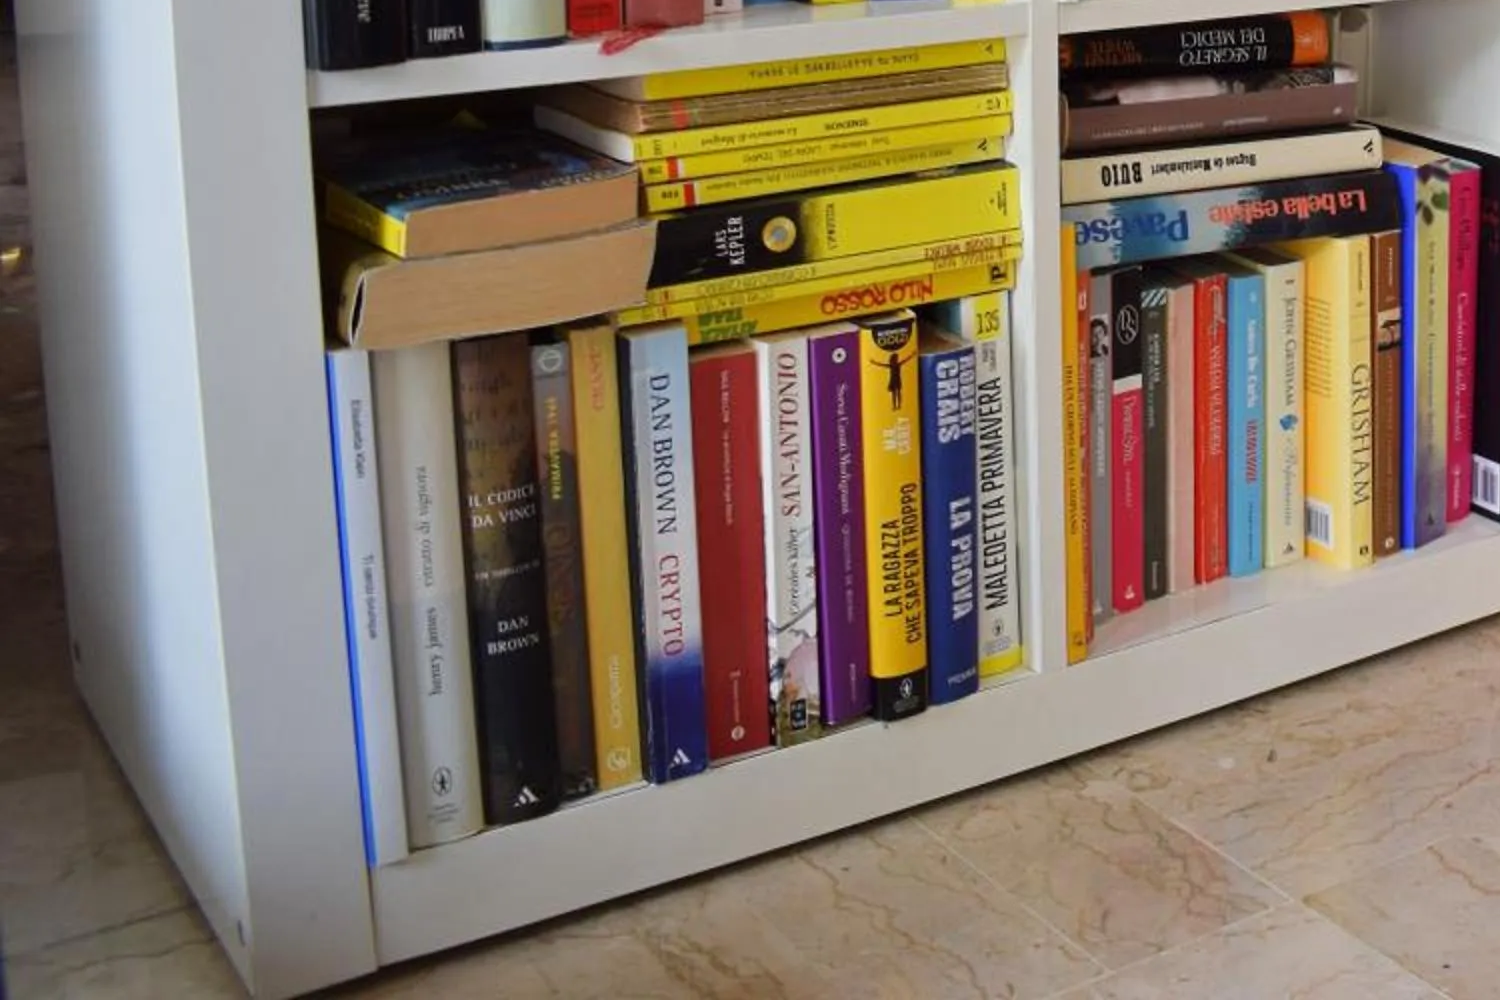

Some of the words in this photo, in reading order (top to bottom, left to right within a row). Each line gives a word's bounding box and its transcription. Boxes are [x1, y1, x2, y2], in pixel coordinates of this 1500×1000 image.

[1180, 29, 1238, 50] MEDICI
[1240, 27, 1266, 46] DEI
[1252, 45, 1268, 63] IL
[1179, 46, 1249, 67] SEGRETO
[1101, 162, 1143, 187] BUIO
[1208, 199, 1279, 223] estate
[1284, 191, 1337, 216] bella
[1338, 190, 1367, 213] La
[715, 228, 728, 258] LARS
[728, 216, 743, 266] KEPLER
[1074, 209, 1189, 246] Pavese
[819, 286, 886, 316] ROSSO
[889, 278, 934, 304] NILO
[650, 373, 672, 433] DAN
[935, 359, 961, 444] CRAIS
[958, 355, 977, 436] ROBERT
[776, 352, 802, 519] SAN-ANTONIO
[977, 377, 1005, 494] PRIMAVERA
[1351, 362, 1372, 506] GRISHAM
[468, 494, 482, 508] IL
[653, 437, 677, 536] BROWN
[471, 510, 495, 530] DA
[498, 502, 537, 524] VINCI
[899, 482, 918, 545] TROPPO
[949, 497, 972, 529] LA
[881, 519, 902, 594] RAGAZZA
[981, 495, 1008, 611] MALEDETTA
[902, 548, 921, 609] SAPEVA
[951, 533, 974, 621] PROVA
[659, 553, 685, 659] CRYPTO
[885, 596, 902, 617] LA
[425, 606, 443, 651] james
[497, 615, 530, 634] DAN
[903, 610, 922, 645] CHE
[487, 632, 540, 657] BROWN
[428, 653, 444, 697] henry
